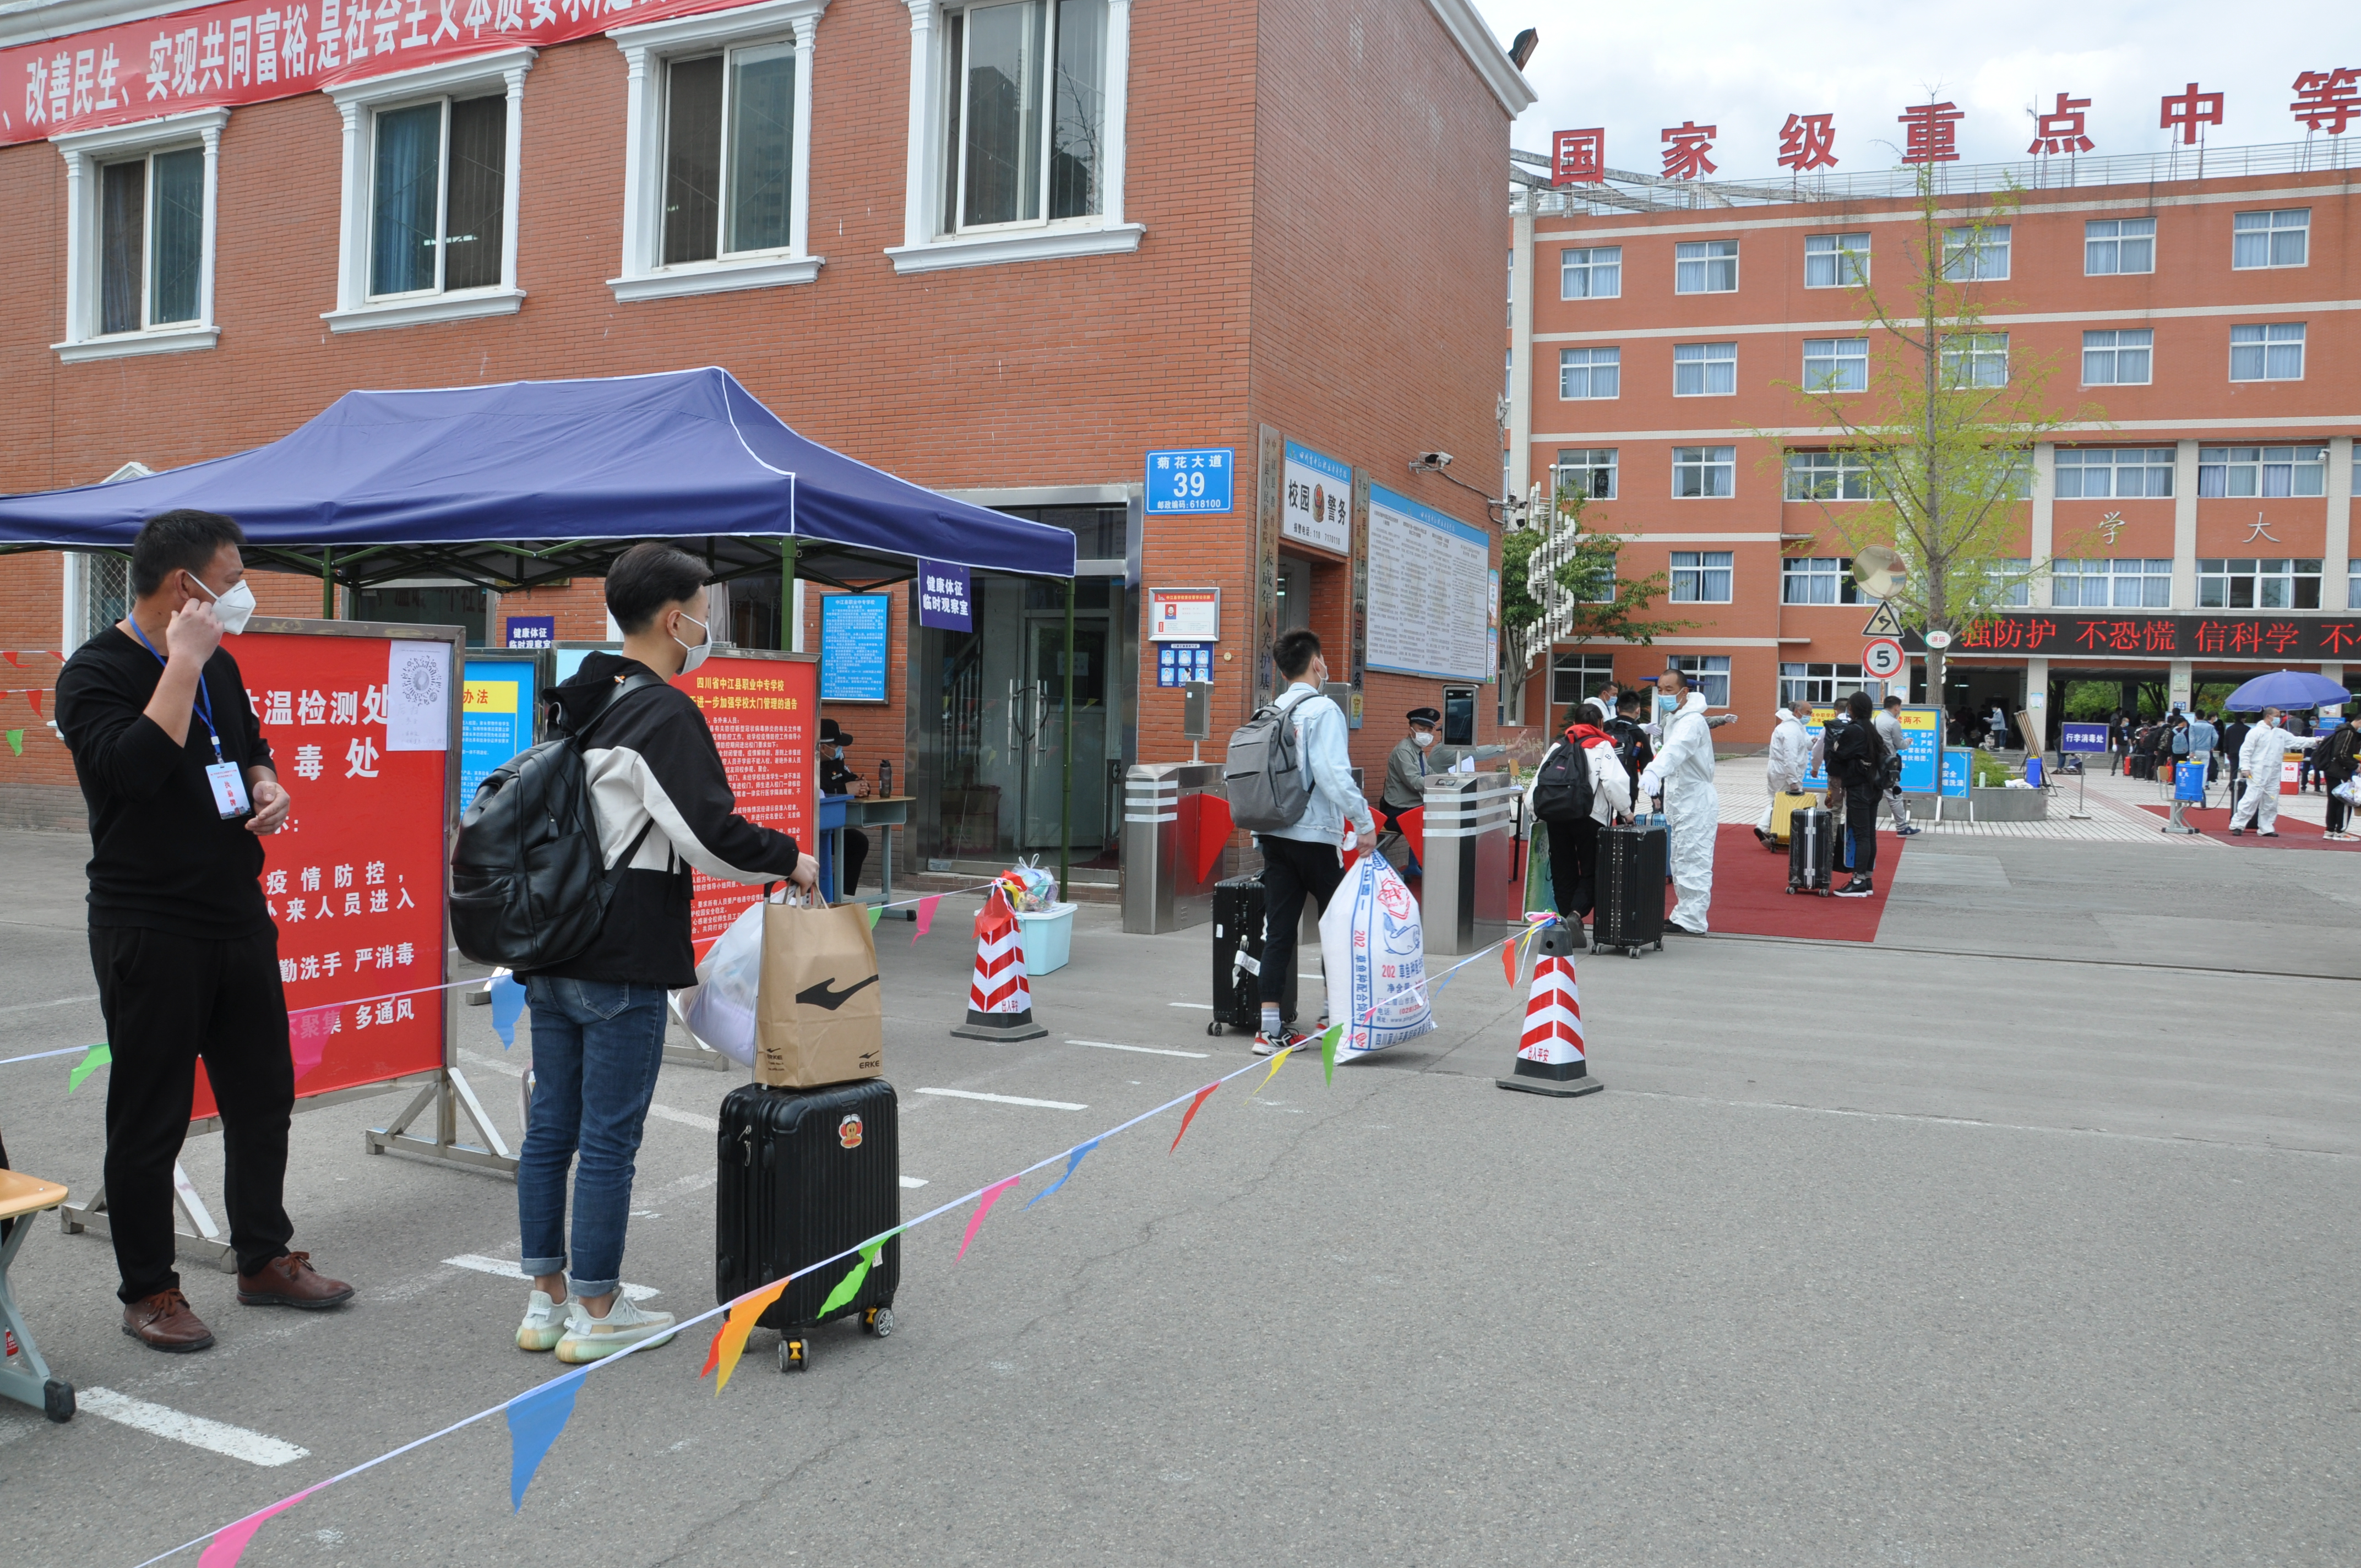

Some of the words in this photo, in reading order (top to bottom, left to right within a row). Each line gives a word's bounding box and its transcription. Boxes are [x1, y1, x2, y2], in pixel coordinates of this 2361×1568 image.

[1157, 454, 1222, 469] 菊花大道
[1173, 471, 1205, 497] 39
[1288, 478, 1310, 513] 校园
[1328, 493, 1346, 526] 警务
[2099, 510, 2125, 545] 学
[2242, 511, 2281, 544] 大
[1324, 533, 1340, 545] 7170110
[926, 574, 964, 596] 健康体征
[923, 593, 969, 616] 临时观察室
[513, 627, 547, 639] 健康体征
[2076, 619, 2176, 651] 不恐慌
[2195, 620, 2299, 654] 信科学
[2320, 623, 2361, 654] 不
[1876, 650, 1891, 668] 5
[697, 677, 785, 692] 四川省中江县职业中专学校
[463, 689, 488, 704] 办法
[2066, 733, 2104, 744] 行李消毒处
[269, 737, 380, 781] 毒处
[1354, 930, 1366, 948] 202
[279, 951, 342, 983] 勤洗手
[353, 942, 415, 973] 严消毒
[1381, 964, 1396, 978] 202
[355, 998, 415, 1031] 多通风
[1528, 1046, 1549, 1062] 出入平安
[859, 1060, 880, 1069] ERKE
